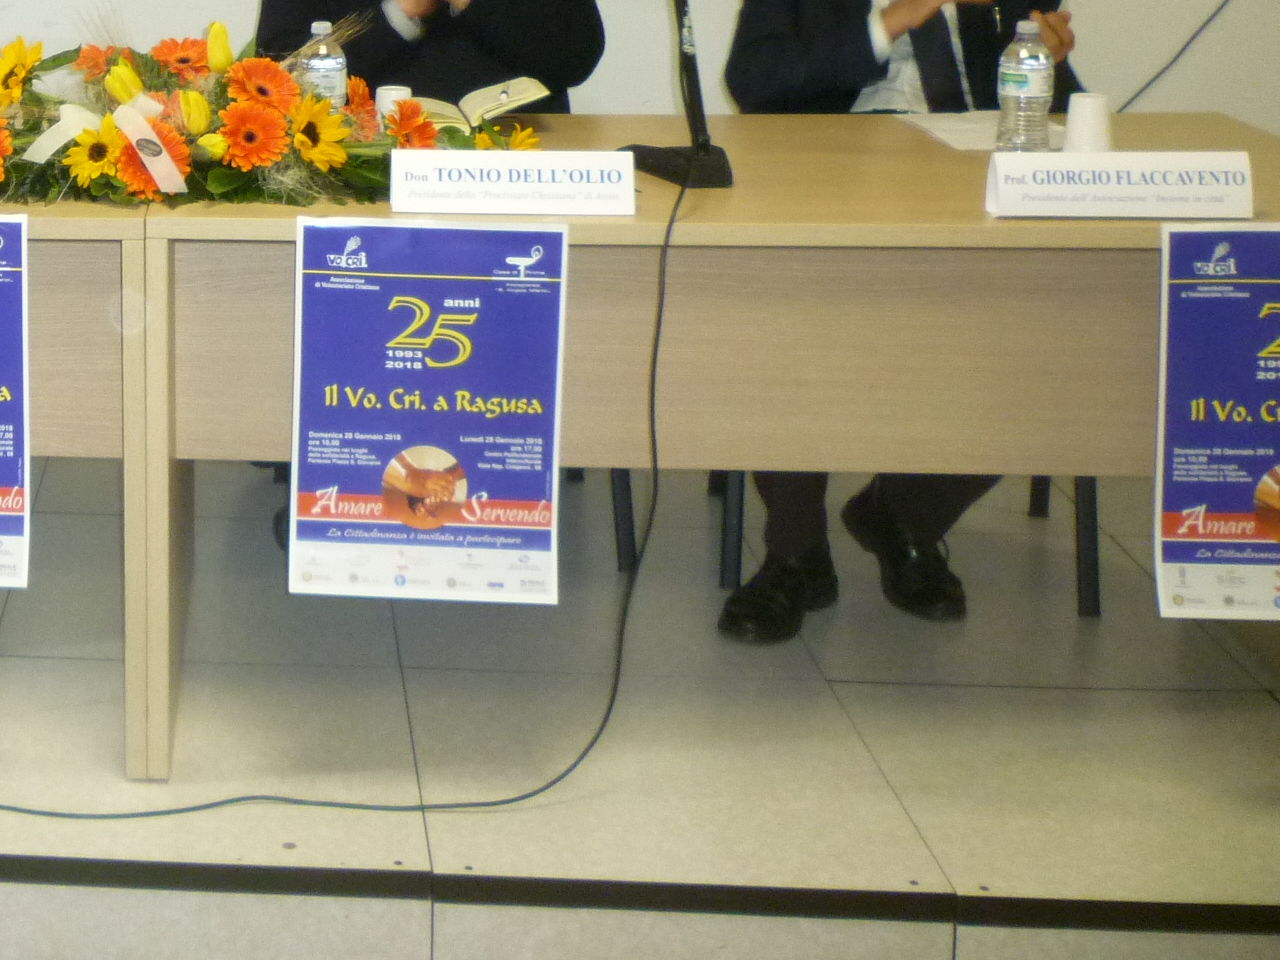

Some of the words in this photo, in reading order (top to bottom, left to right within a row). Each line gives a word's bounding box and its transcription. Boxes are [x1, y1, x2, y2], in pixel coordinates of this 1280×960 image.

[404, 172, 428, 182] Don
[433, 167, 502, 183] TONIO
[507, 168, 623, 184] DELL'OLIO
[1032, 169, 1112, 186] GIORGIO
[1115, 169, 1247, 186] FLACCAVENTO
[443, 298, 480, 307] anni
[385, 296, 477, 367] 25
[385, 350, 422, 358] 1993
[385, 361, 422, 369] 2018
[324, 384, 338, 406] Il
[344, 387, 382, 409] Vo.
[389, 389, 426, 410] Cri.
[433, 396, 449, 411] a
[454, 390, 543, 418] Ragusa
[1191, 398, 1206, 421] Il
[1212, 400, 1253, 422] Vo.
[311, 486, 382, 515] Amare
[461, 492, 550, 523] Servendo
[1177, 504, 1256, 534] Amare
